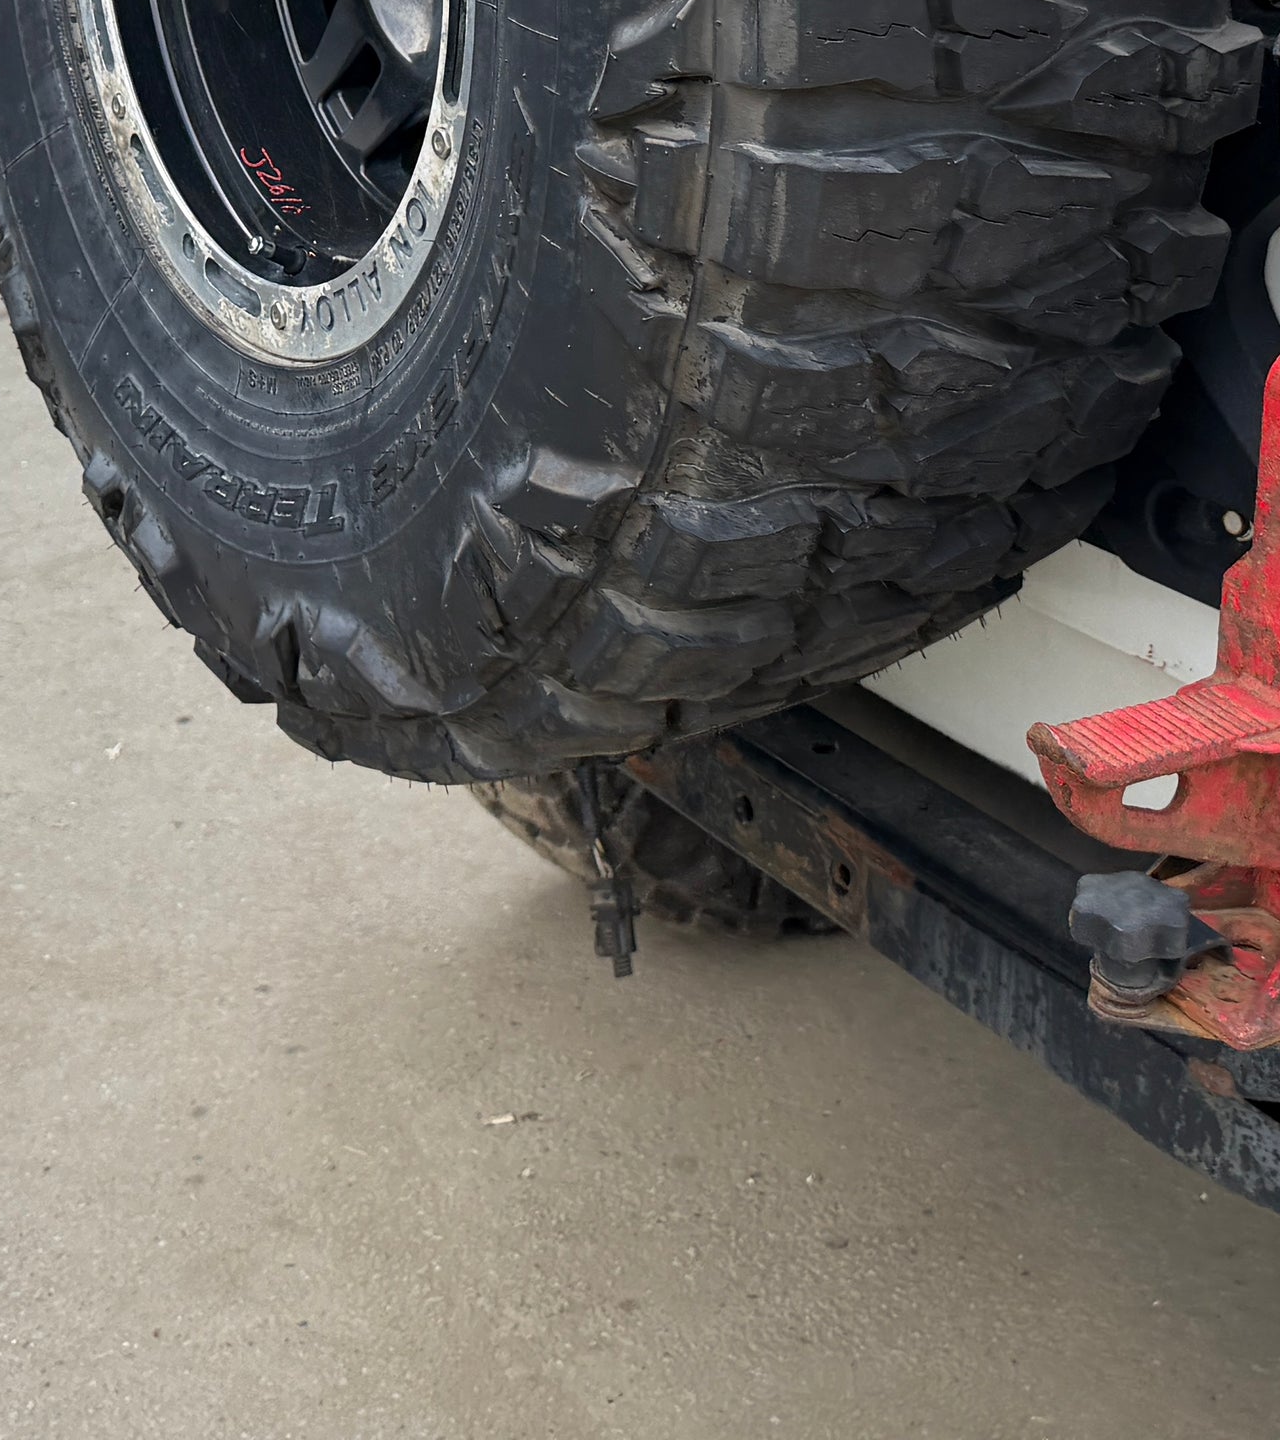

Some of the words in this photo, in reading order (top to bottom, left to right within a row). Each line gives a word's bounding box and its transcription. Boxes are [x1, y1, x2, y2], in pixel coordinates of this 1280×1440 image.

[389, 179, 437, 270] ION
[299, 261, 382, 335] ALLOY
[114, 377, 345, 537] TERRAIN
